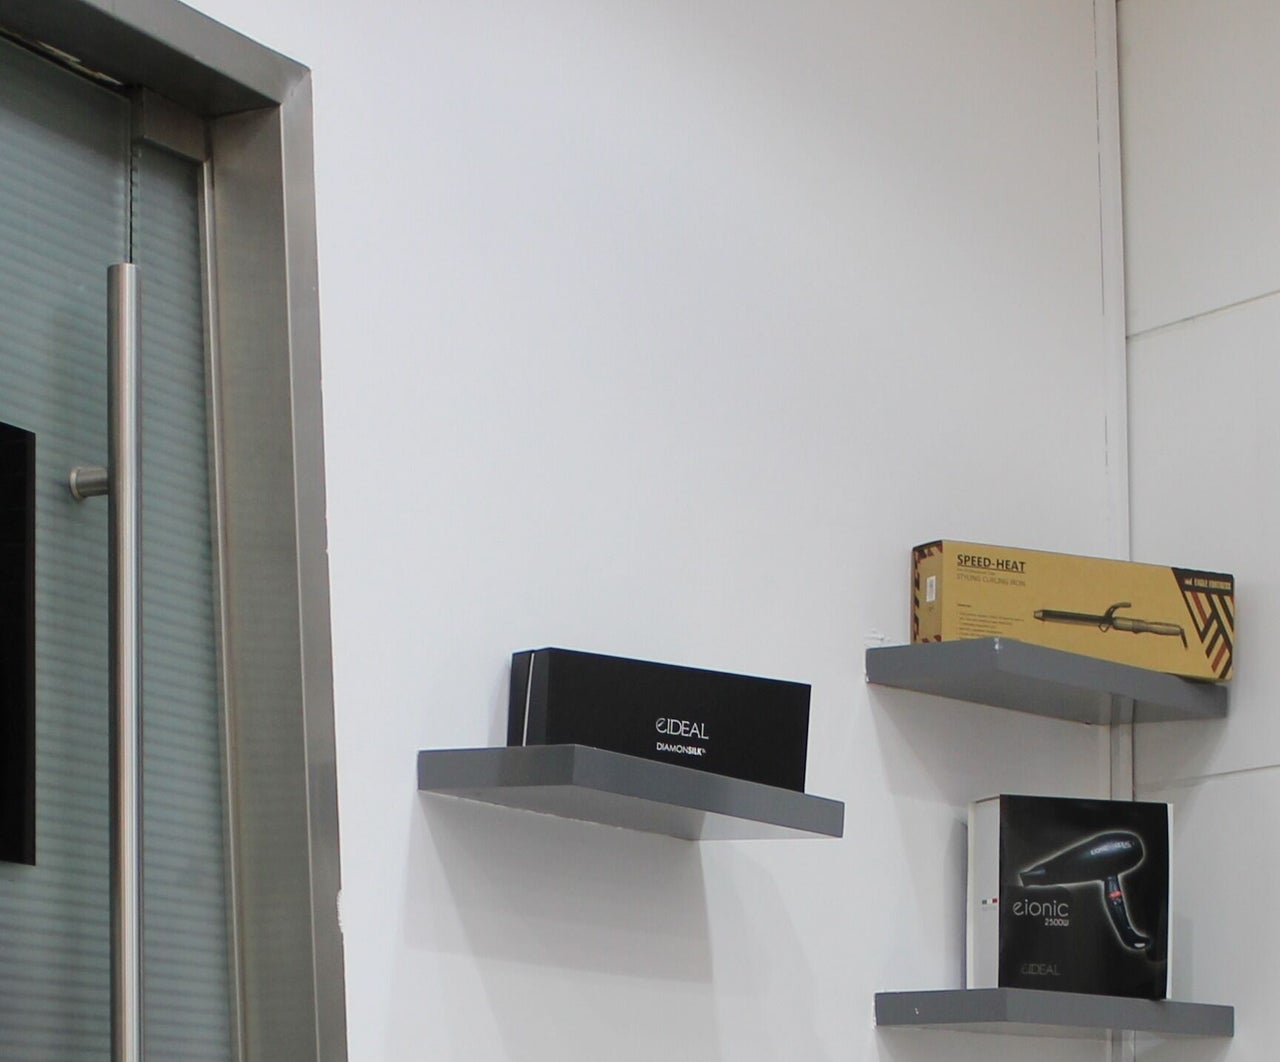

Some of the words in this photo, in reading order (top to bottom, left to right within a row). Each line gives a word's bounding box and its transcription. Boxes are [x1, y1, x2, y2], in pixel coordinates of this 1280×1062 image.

[957, 554, 1026, 573] SPEED-HEAT
[1012, 900, 1069, 917] eionic
[1044, 918, 1070, 927] 2500W
